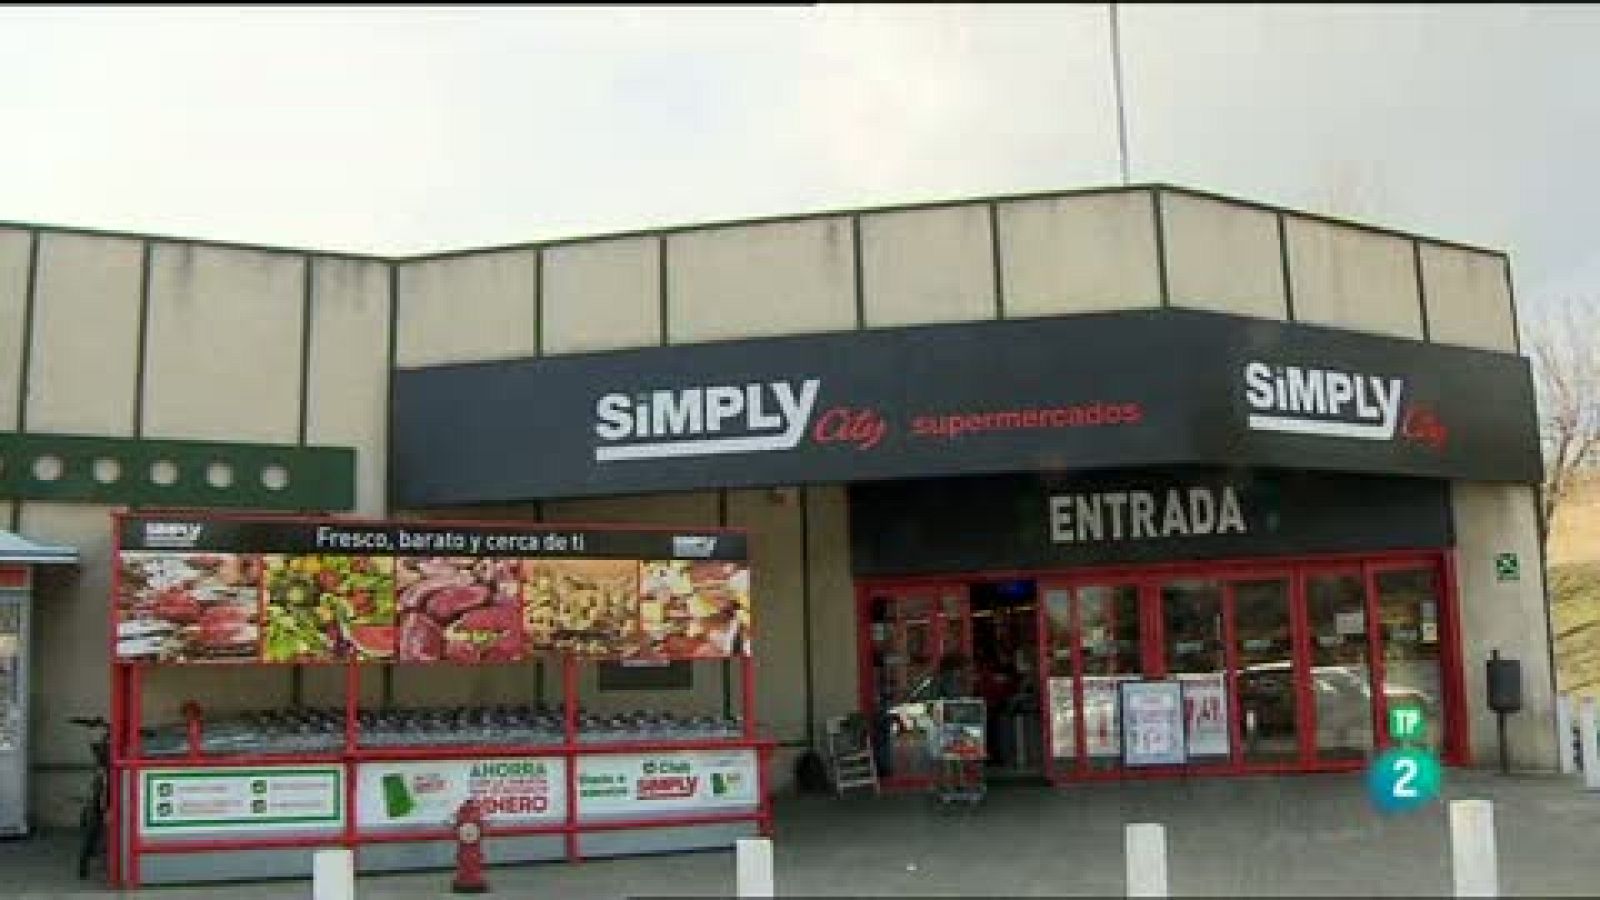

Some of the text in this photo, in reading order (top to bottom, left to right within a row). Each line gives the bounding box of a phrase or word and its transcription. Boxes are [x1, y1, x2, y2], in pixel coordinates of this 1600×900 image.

[813, 407, 887, 450] City
[911, 401, 1143, 436] supermercados
[1049, 487, 1248, 541] ENTRADA
[316, 526, 585, 554] Fresco, barato y cerca de ti
[470, 762, 547, 777] AHORRA
